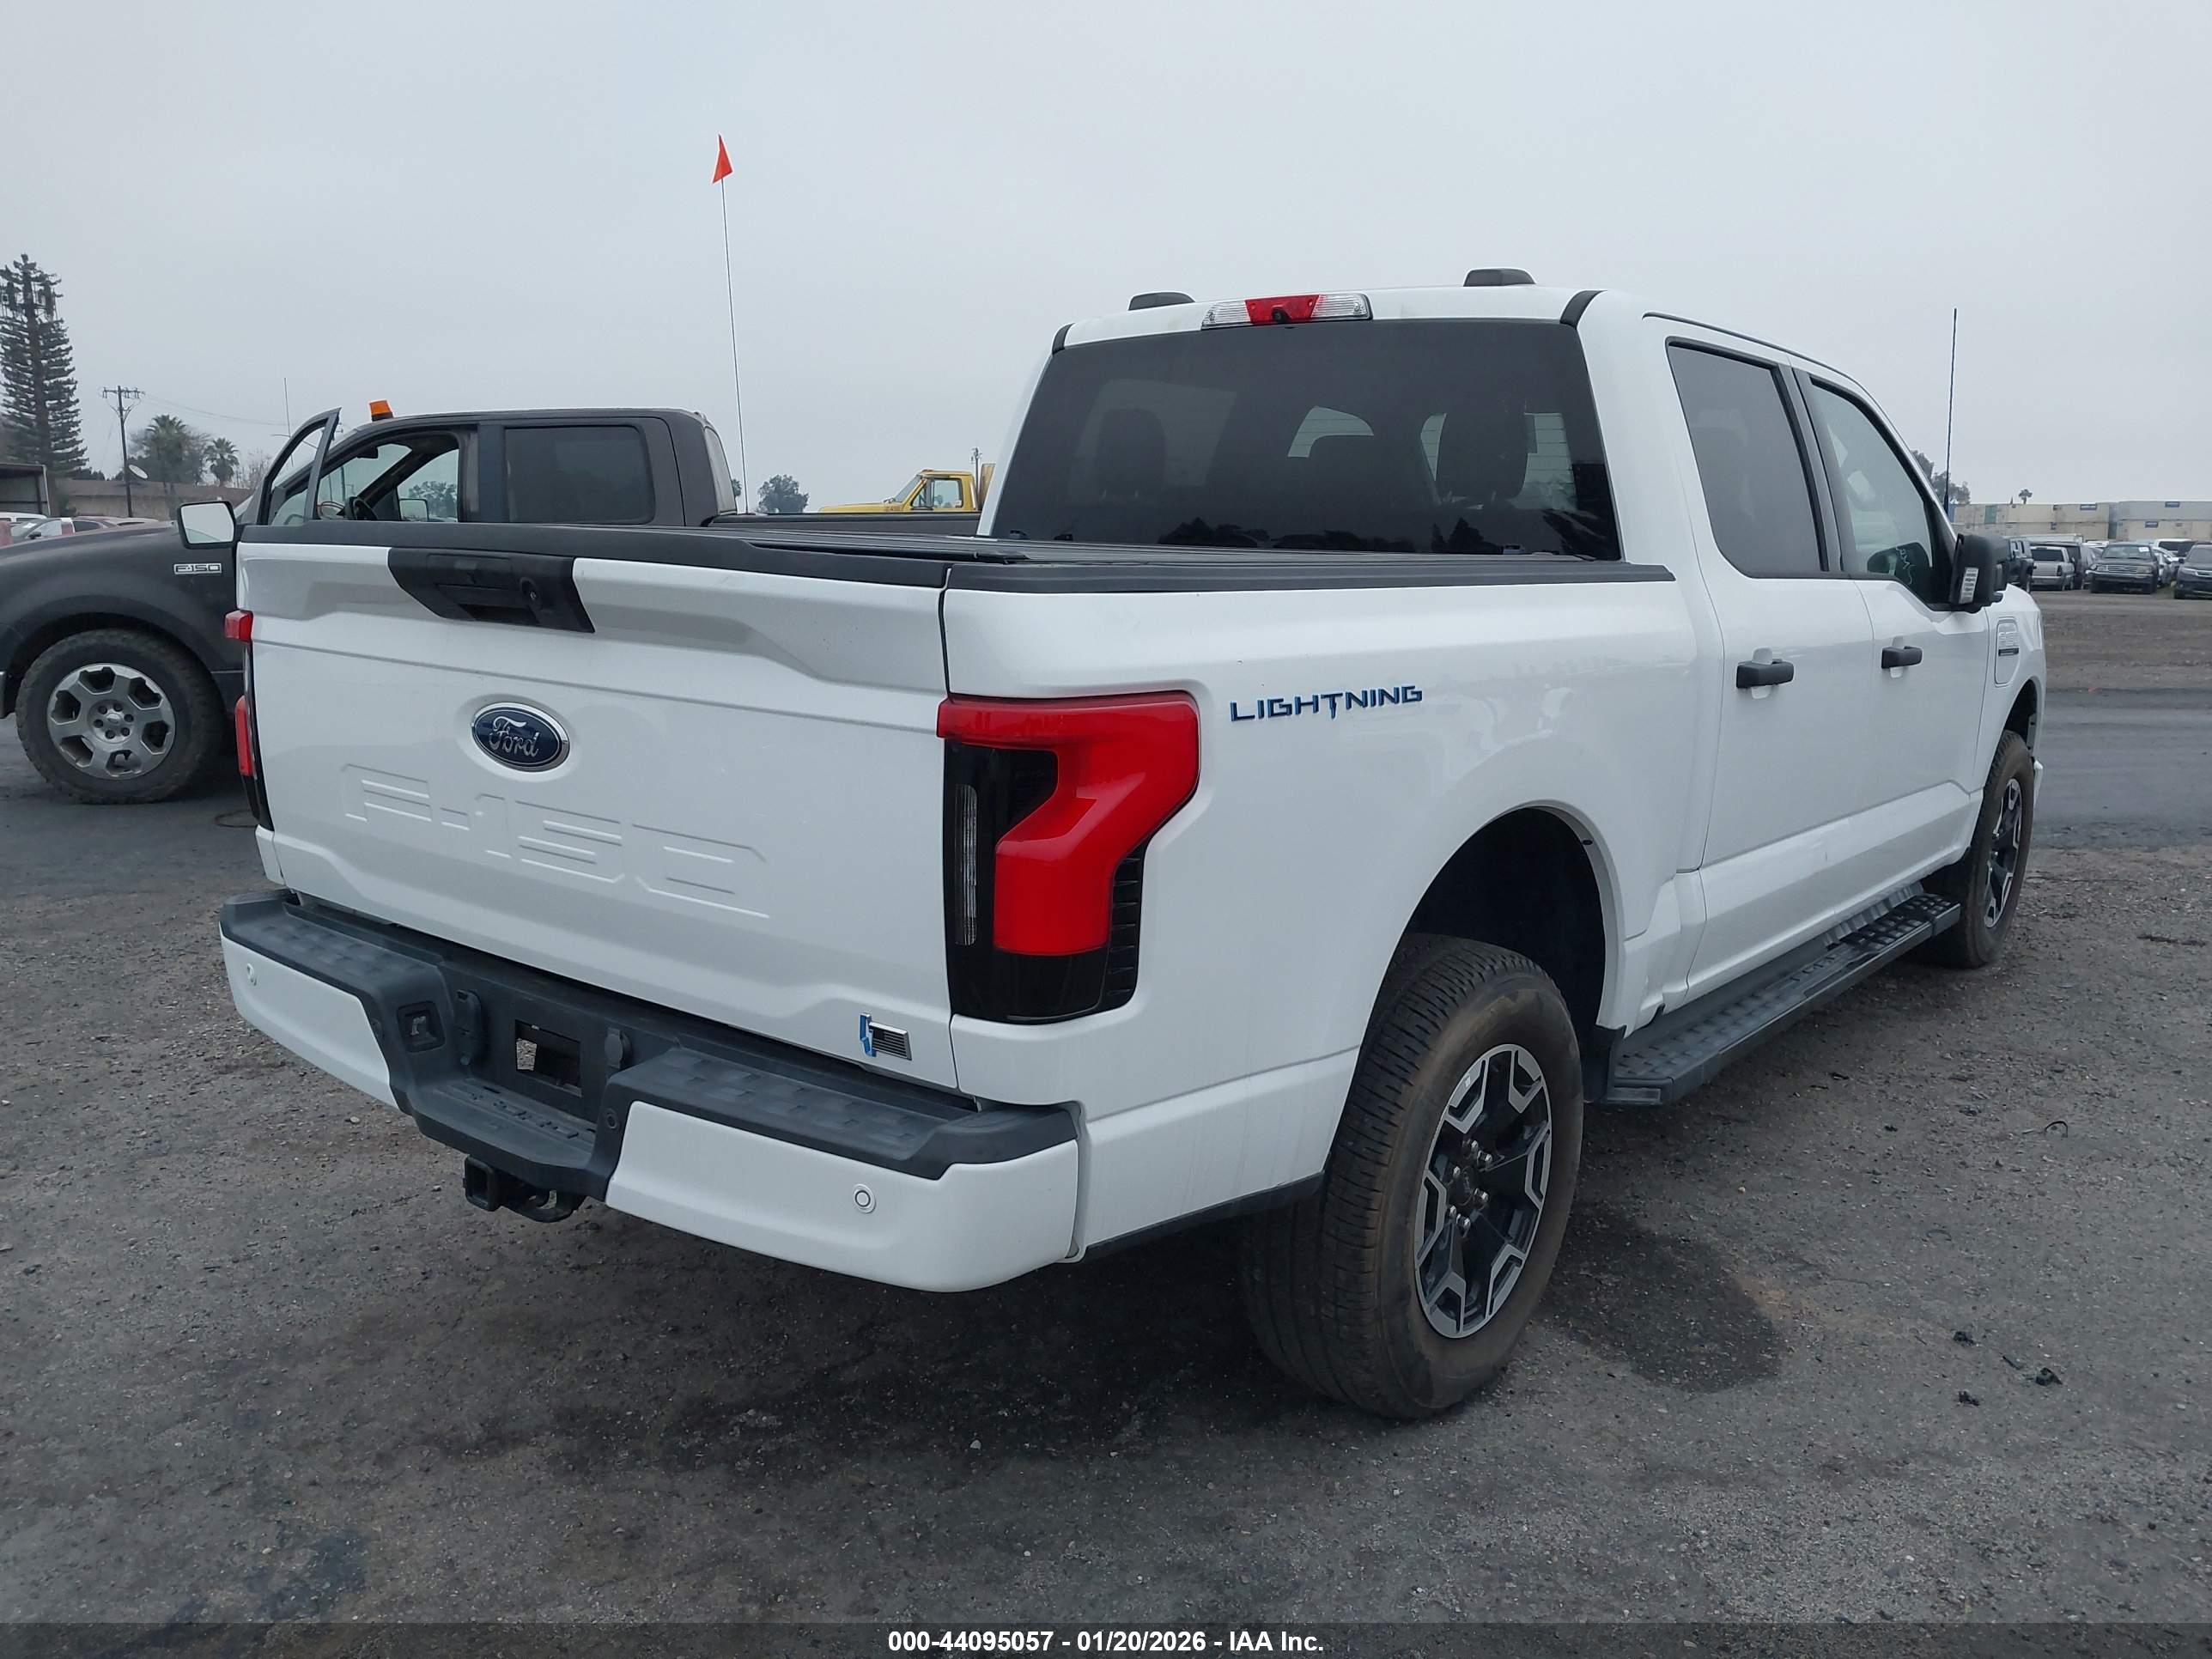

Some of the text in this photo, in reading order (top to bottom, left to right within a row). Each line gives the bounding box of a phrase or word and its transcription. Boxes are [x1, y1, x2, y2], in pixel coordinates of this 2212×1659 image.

[174, 563, 222, 574] F-150
[1231, 685, 1423, 721] LIGHTNING
[489, 715, 540, 757] Ford
[342, 763, 771, 919] F-150
